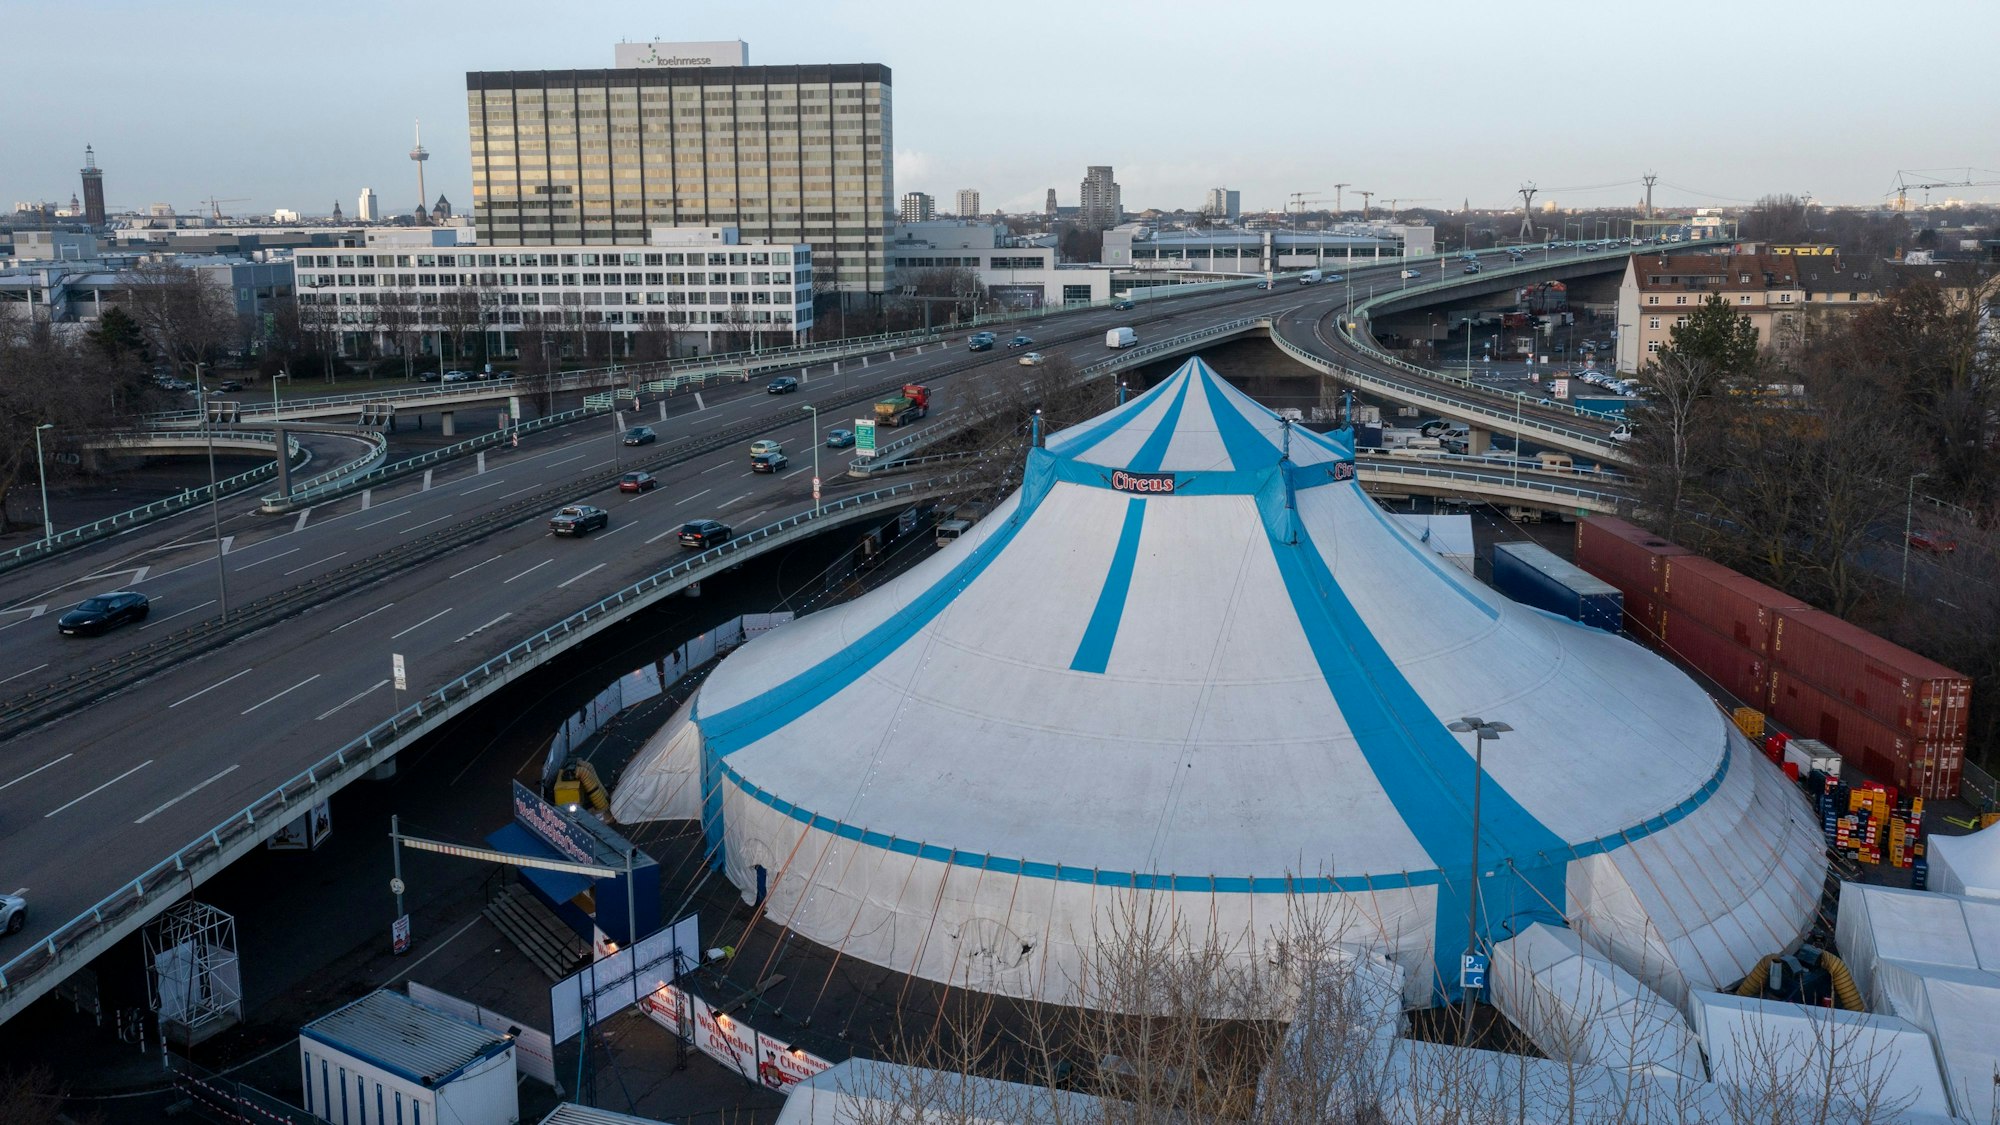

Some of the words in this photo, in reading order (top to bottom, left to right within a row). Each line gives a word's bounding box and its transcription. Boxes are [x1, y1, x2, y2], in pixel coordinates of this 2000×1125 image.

[657, 56, 711, 66] koelnmesse
[1112, 471, 1173, 491] Circus
[1473, 976, 1482, 986] C
